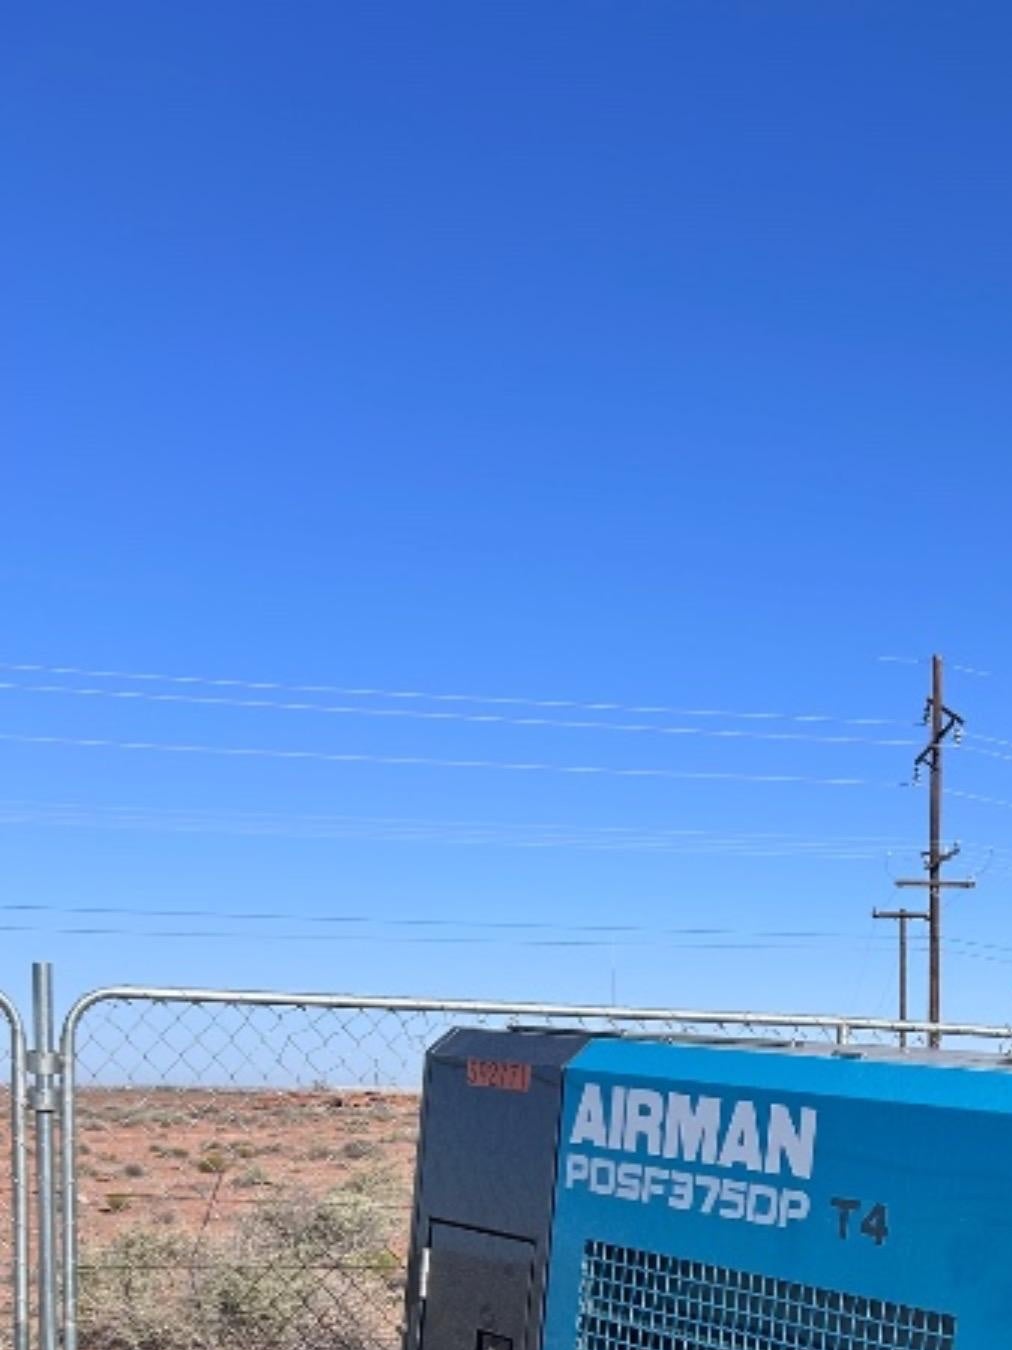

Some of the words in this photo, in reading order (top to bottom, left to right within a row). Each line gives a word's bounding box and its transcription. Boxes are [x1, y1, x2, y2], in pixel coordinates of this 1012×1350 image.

[569, 1083, 817, 1180] AIRMAN
[565, 1154, 811, 1228] PDSF375DP
[830, 1197, 890, 1246] T4
